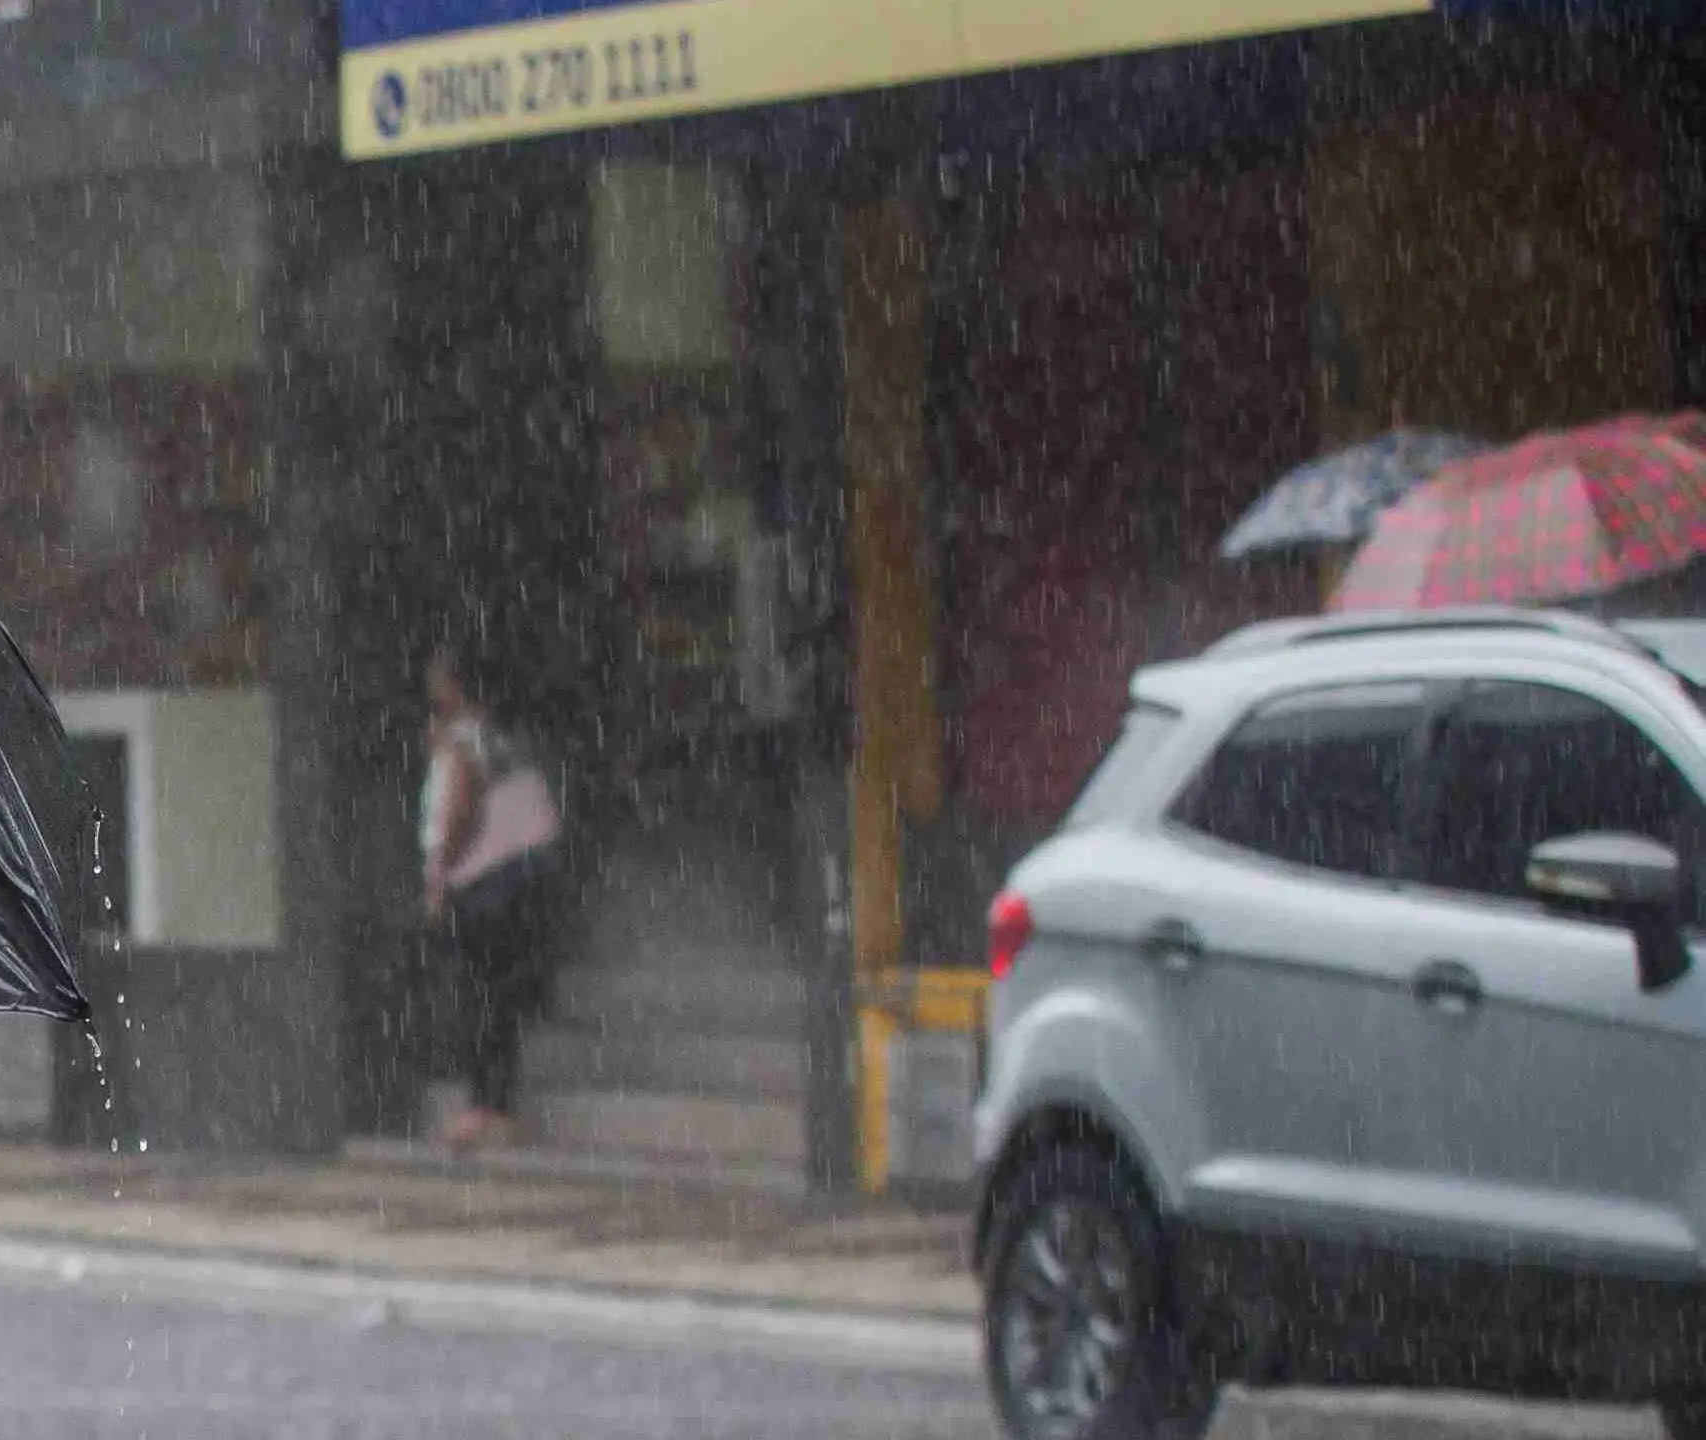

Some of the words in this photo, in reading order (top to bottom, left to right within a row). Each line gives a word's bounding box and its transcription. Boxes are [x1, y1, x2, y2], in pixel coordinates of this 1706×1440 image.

[416, 57, 510, 127] 0800
[520, 46, 594, 108] 270
[602, 28, 698, 99] 1111
